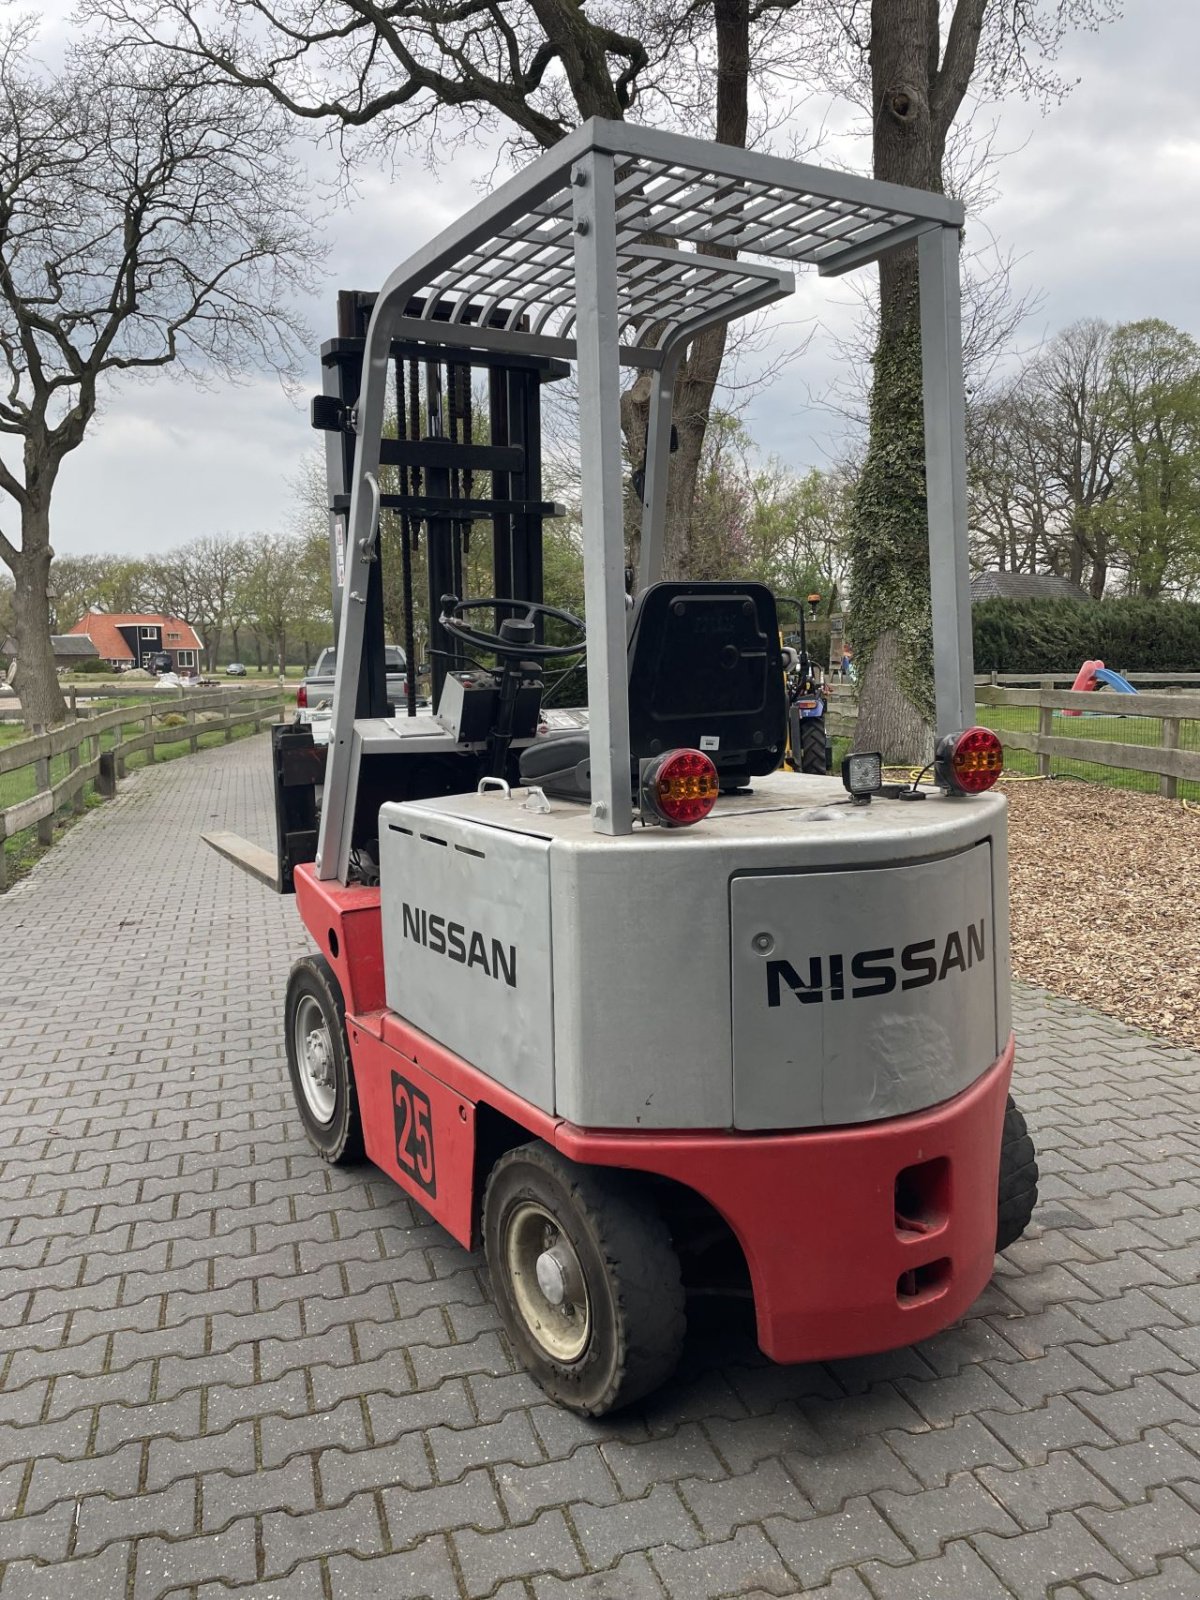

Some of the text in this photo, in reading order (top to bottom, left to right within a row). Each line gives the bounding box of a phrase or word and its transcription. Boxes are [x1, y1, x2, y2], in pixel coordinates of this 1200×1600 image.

[403, 903, 517, 988] NISSAN
[766, 919, 985, 1008] NISSAN
[394, 1082, 434, 1186] 25
